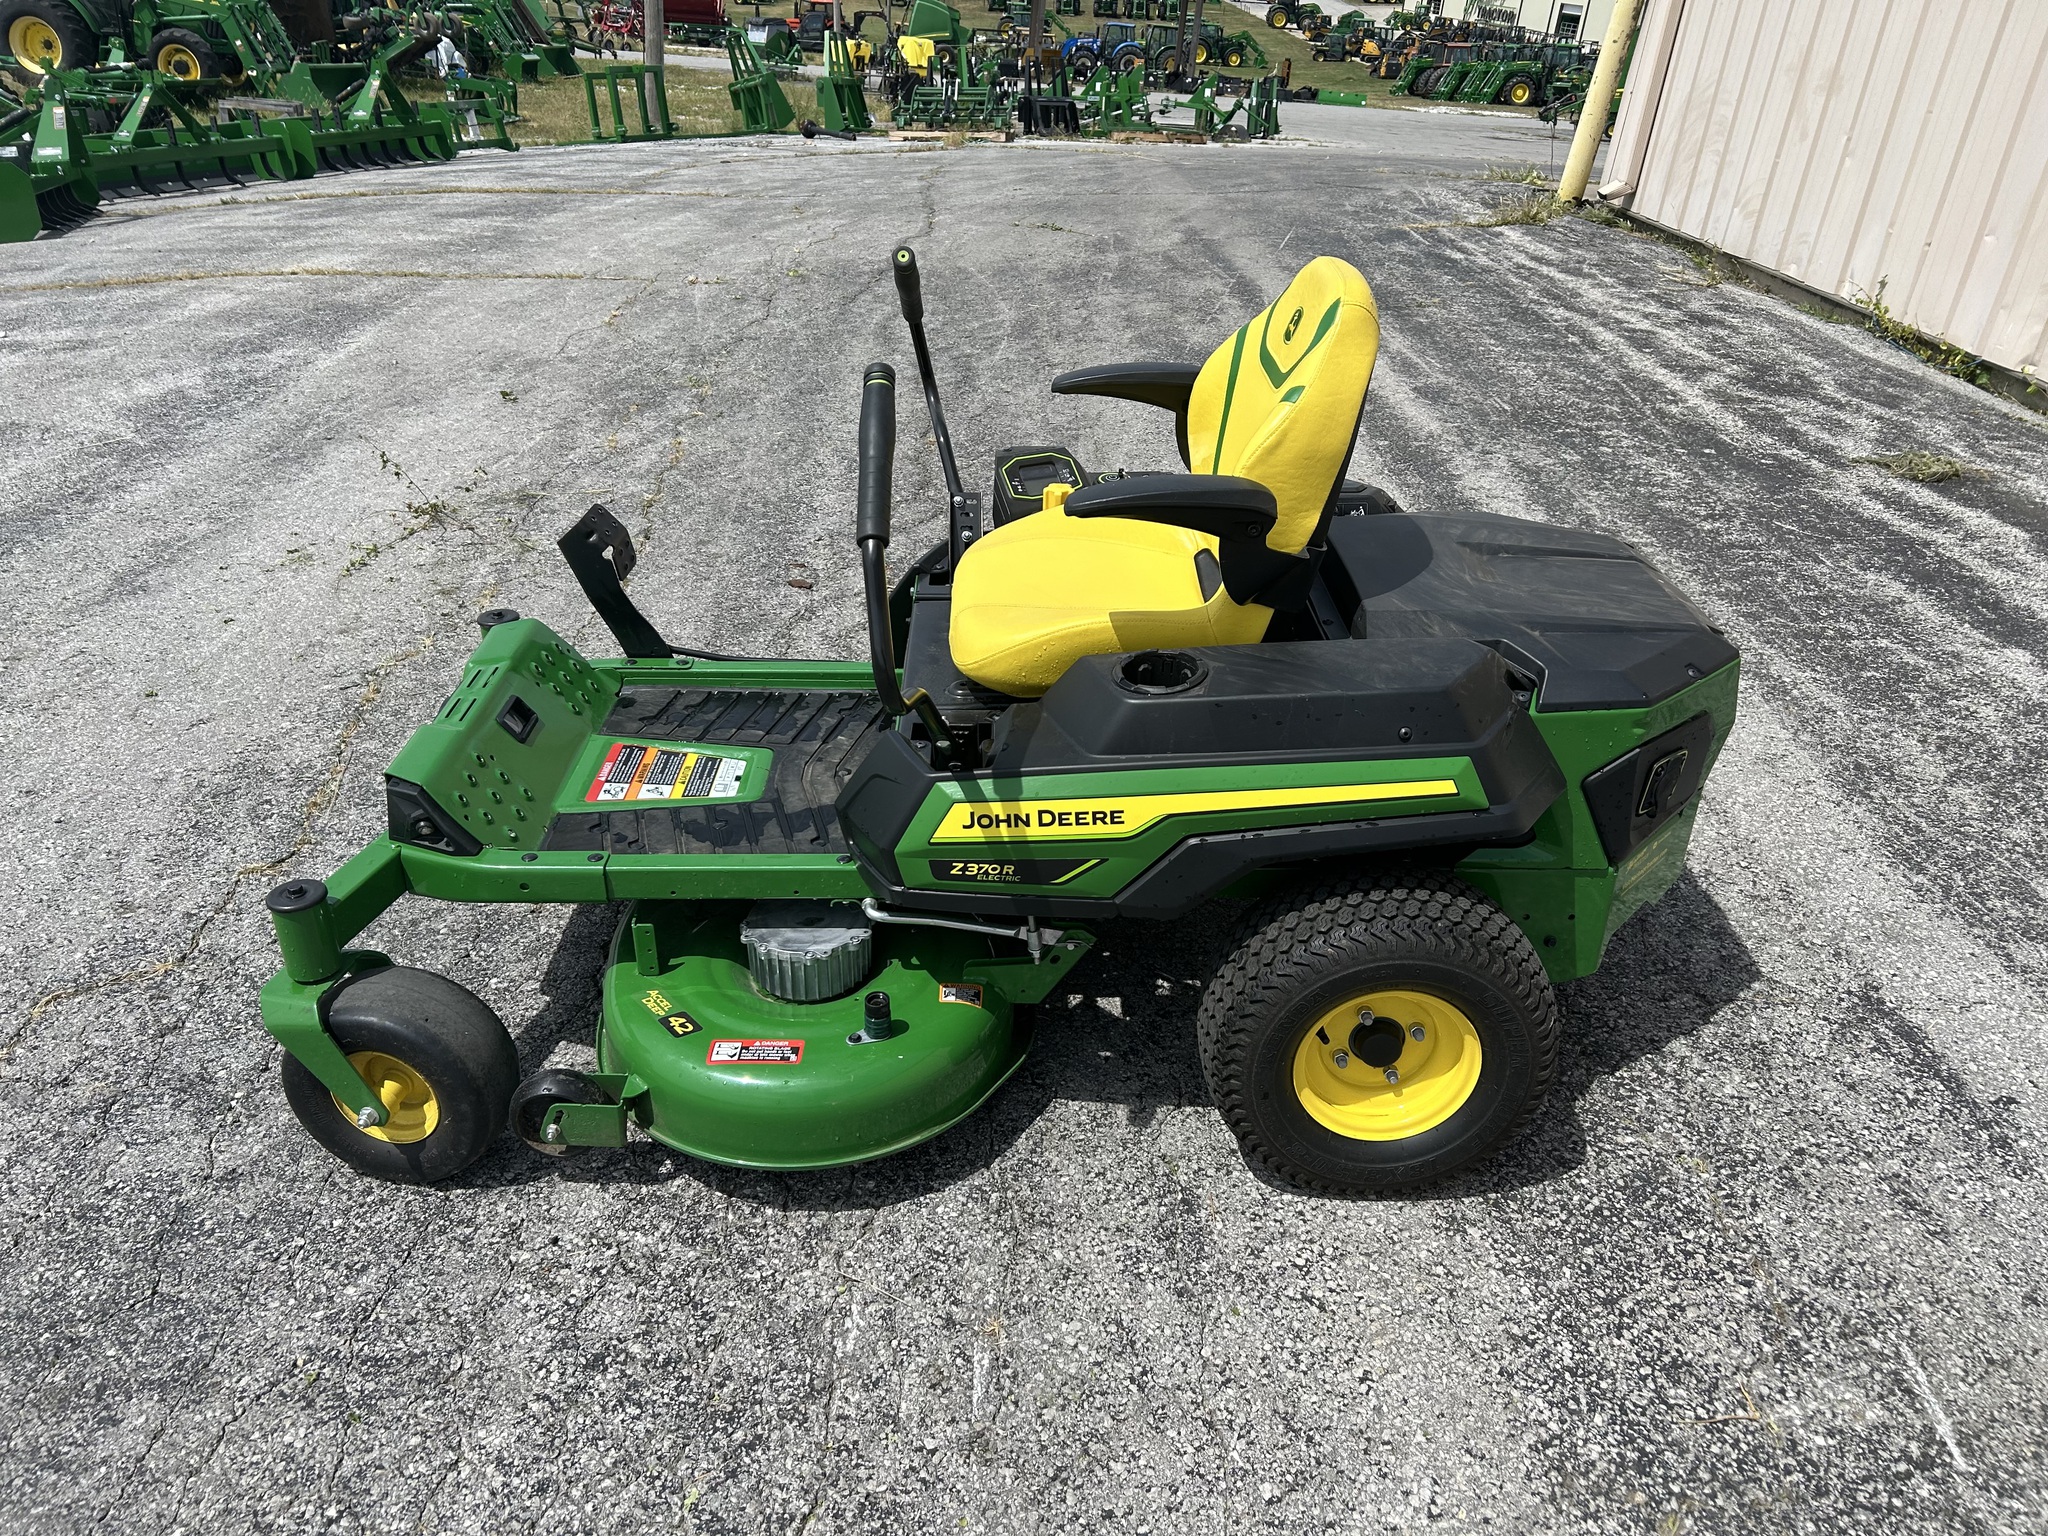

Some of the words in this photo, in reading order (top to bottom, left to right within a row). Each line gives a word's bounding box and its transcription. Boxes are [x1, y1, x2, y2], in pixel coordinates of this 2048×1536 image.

[962, 811, 1030, 830] JOHN
[1037, 809, 1125, 827] DEERE
[976, 874, 1021, 882] ELECTRIC
[641, 997, 666, 1017] DEEP
[646, 989, 673, 1012] ACCEL
[668, 1015, 694, 1035] 42
[1257, 988, 1329, 1069] KENDA
[1475, 991, 1529, 1073] SUPER
